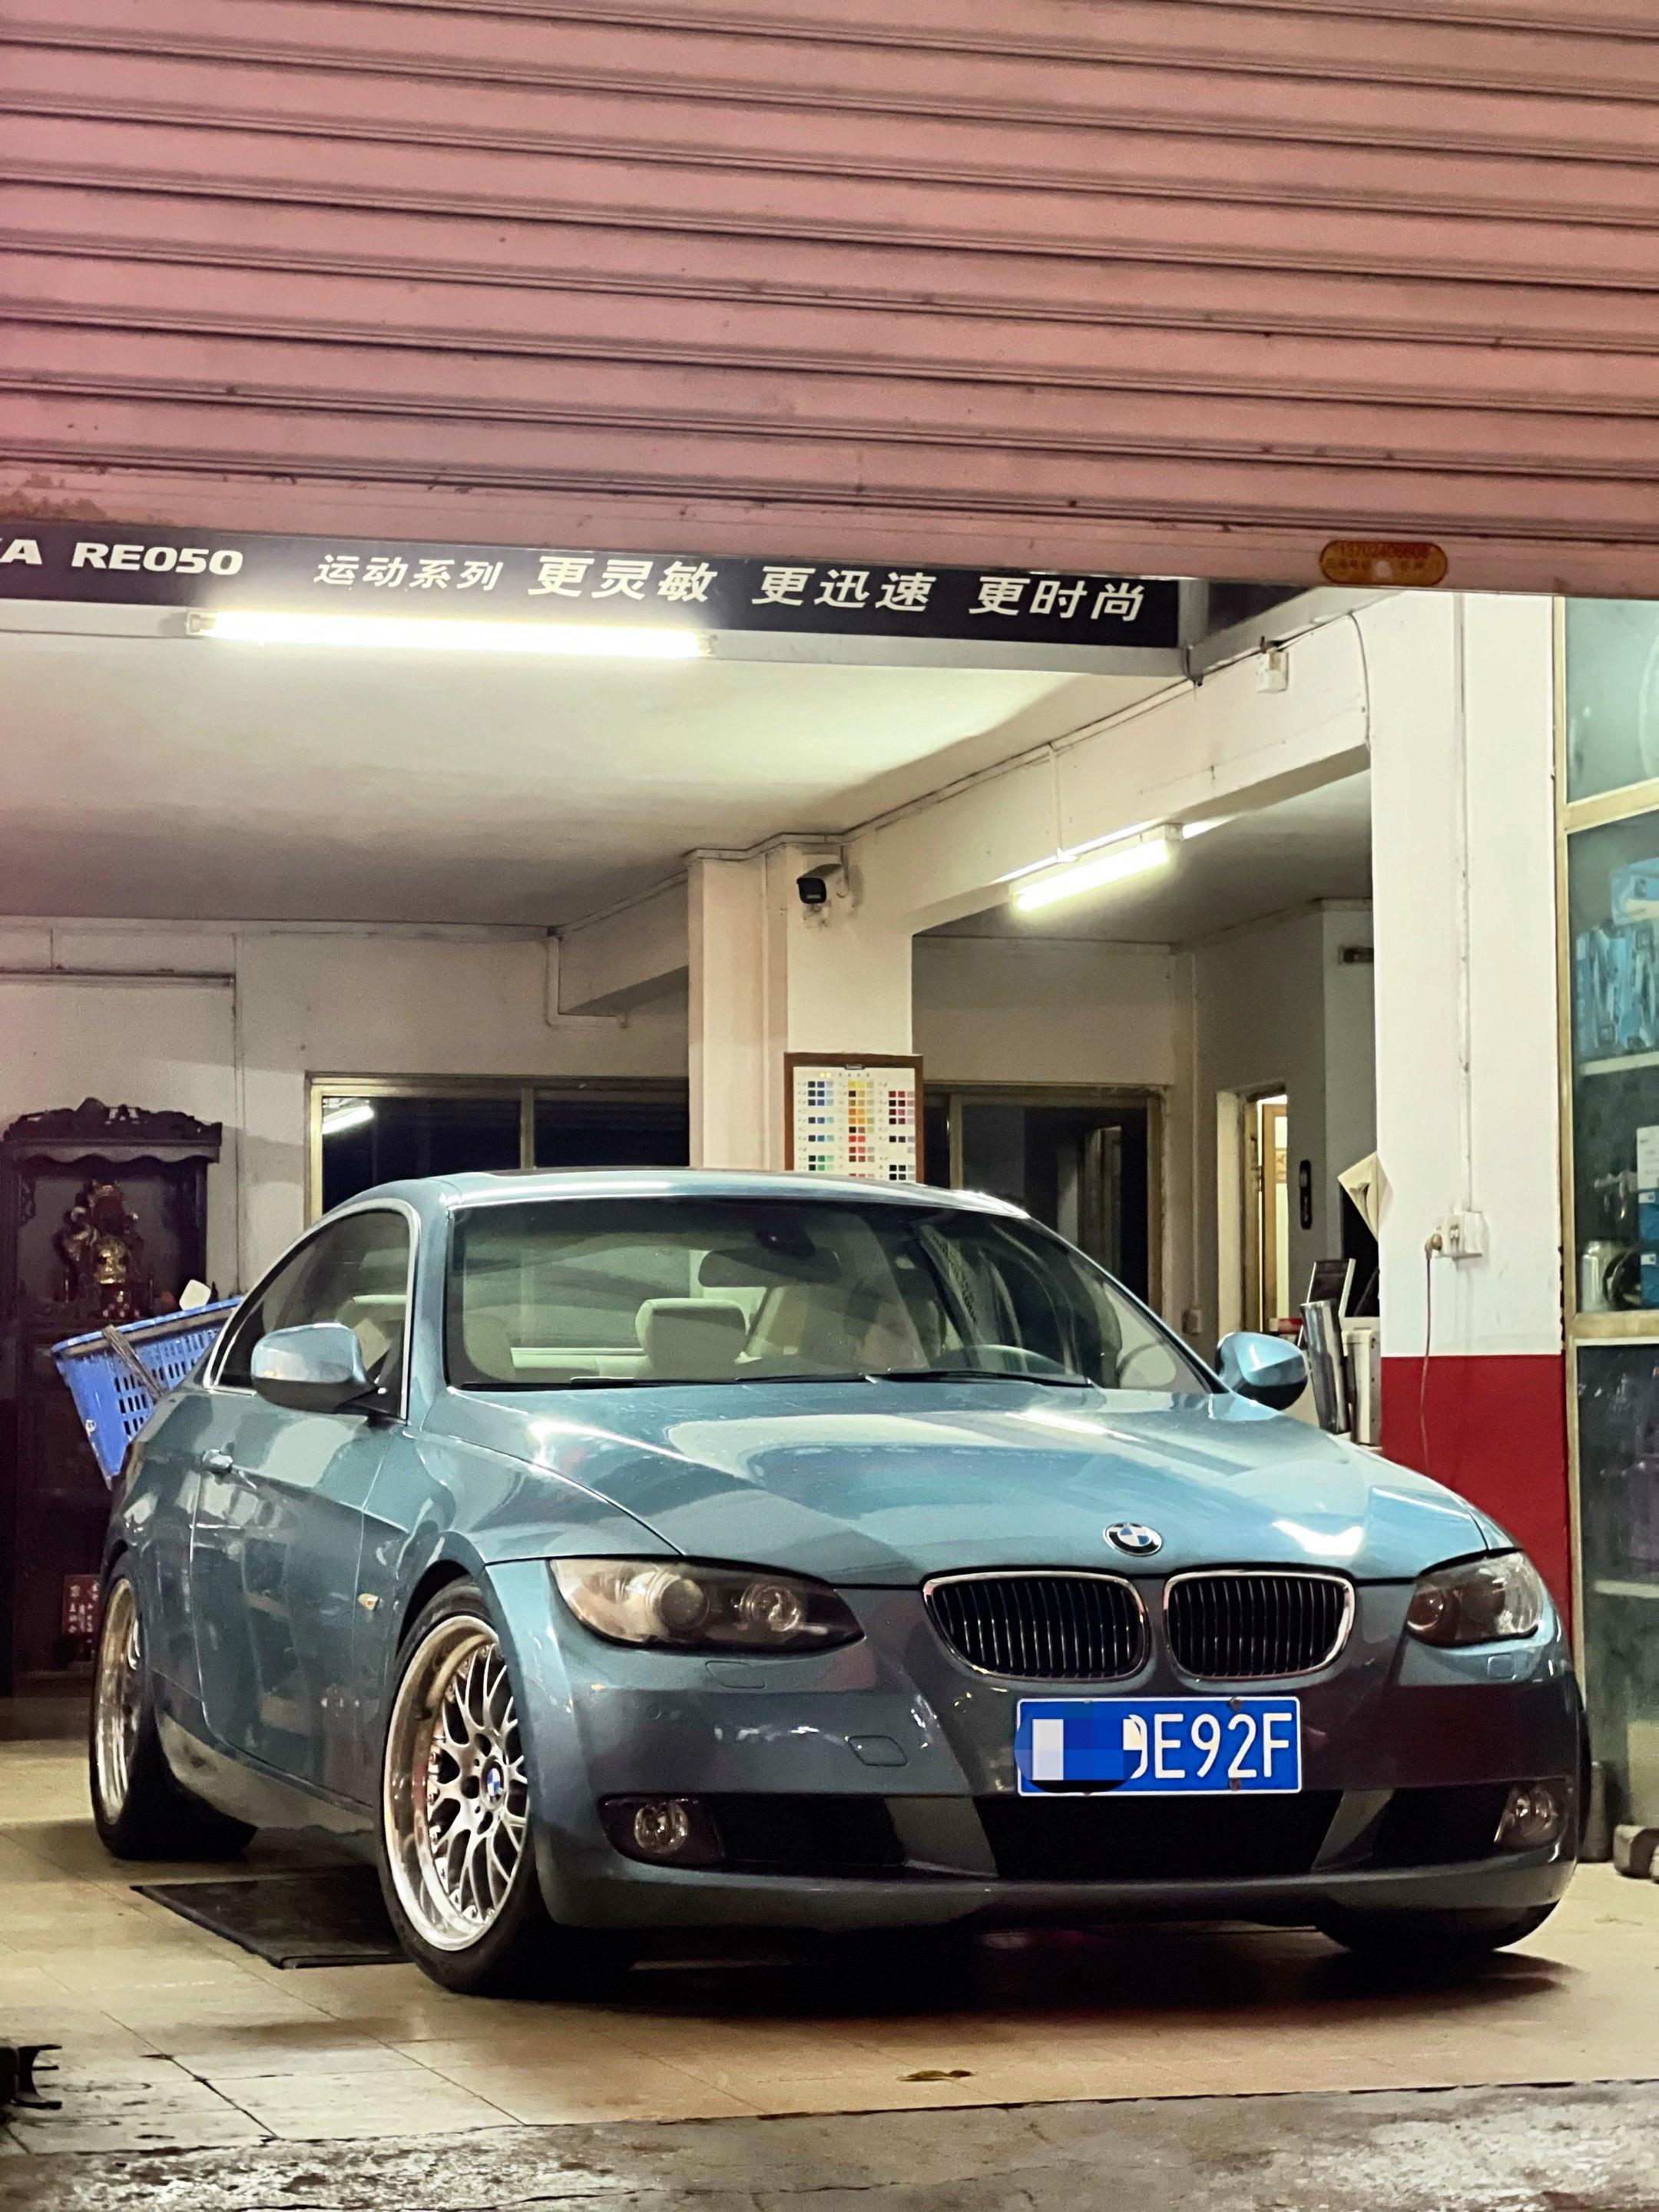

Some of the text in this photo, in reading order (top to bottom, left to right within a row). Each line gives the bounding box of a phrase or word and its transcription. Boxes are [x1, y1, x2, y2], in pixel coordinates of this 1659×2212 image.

[0, 537, 43, 565] A
[313, 554, 1145, 622] 运动系列 更灵敏 更迅速 更时尚
